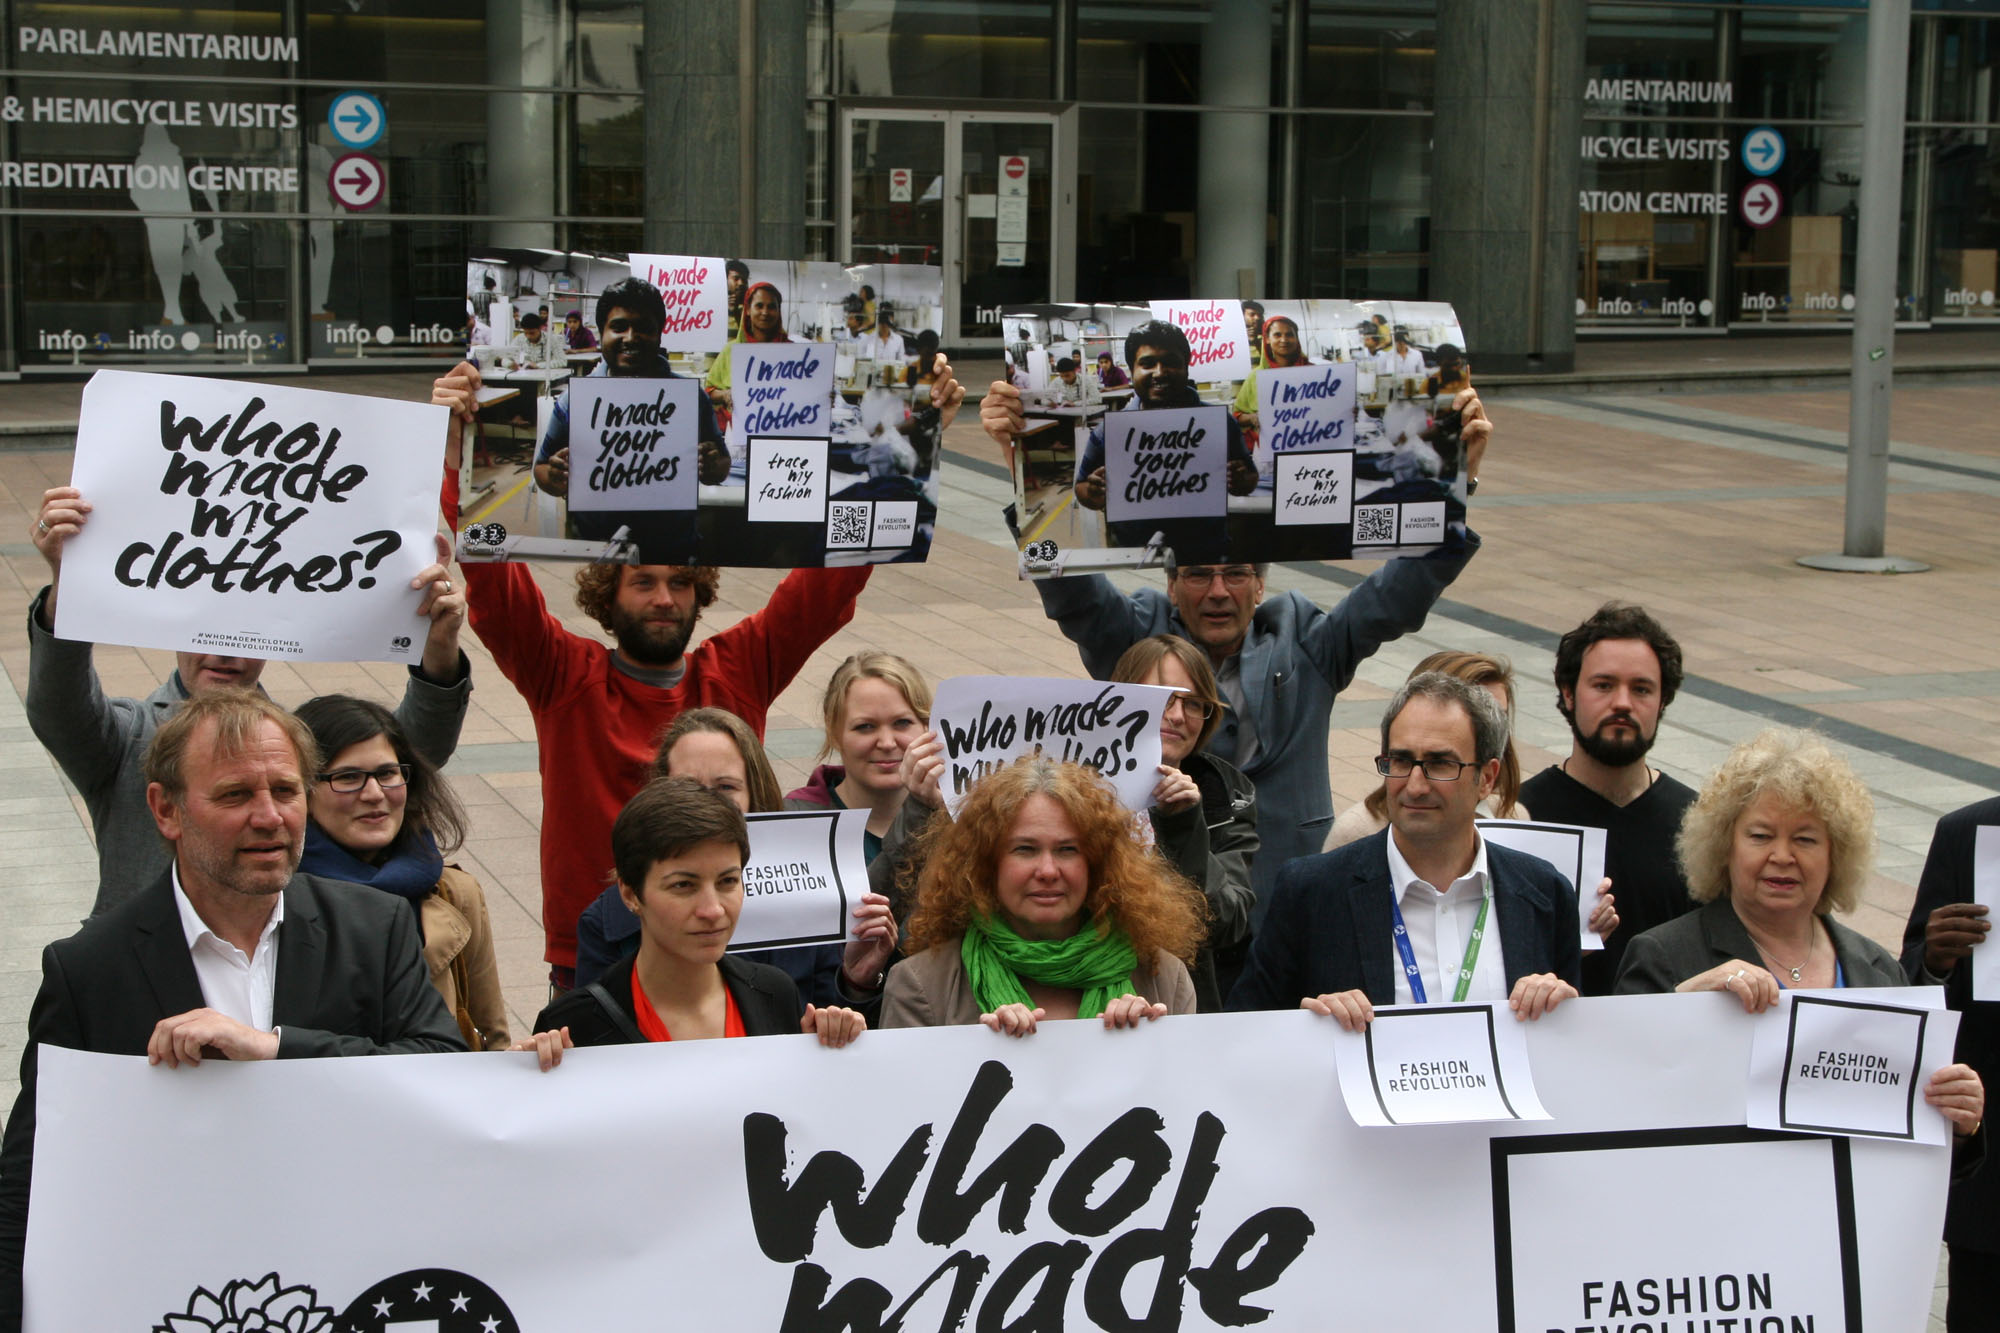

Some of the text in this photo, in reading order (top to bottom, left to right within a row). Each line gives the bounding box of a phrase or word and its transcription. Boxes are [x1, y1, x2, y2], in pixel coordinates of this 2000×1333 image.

[19, 27, 298, 62] PARLAMENTARIUM
[1584, 78, 1733, 103] AMENTARIUM
[1, 96, 298, 129] & HEMICYCLE VISITS
[1665, 138, 1730, 160] VISITS
[0, 162, 298, 192] REDITATION CENTRE
[1647, 192, 1728, 214] CENTRE
[648, 257, 708, 287] I made
[1598, 298, 1695, 315] info info
[1742, 293, 1837, 310] info info
[1945, 288, 1977, 305] info
[662, 307, 714, 334] othes
[976, 304, 1002, 324] inf
[1168, 300, 1224, 326] I made
[39, 330, 262, 350] info info info
[326, 323, 453, 344] info info
[745, 347, 820, 383] I made
[1188, 341, 1235, 367] othes
[745, 386, 787, 407] your
[1271, 368, 1342, 406] I made
[591, 388, 676, 430] I made
[744, 402, 821, 434] clothes
[1272, 406, 1311, 427] your
[160, 397, 320, 463] who
[1125, 416, 1206, 452] I made
[1271, 420, 1344, 450] clothes
[596, 429, 666, 463] your
[160, 427, 369, 502] made
[589, 453, 680, 492] clothes
[768, 452, 809, 470] trace
[1130, 451, 1195, 478] your
[1294, 466, 1334, 481] trace
[788, 469, 813, 486] my
[1124, 470, 1210, 503] clothes
[1314, 480, 1339, 493] my
[759, 482, 812, 503] fashion
[1285, 492, 1337, 509] fashion
[190, 497, 310, 549] my
[114, 531, 402, 593] clothes?
[191, 638, 304, 654] FASHIONREVOLUTION.ORG
[198, 632, 300, 647] #WHOMADEMYCLOTHES
[940, 685, 1125, 759] who made
[745, 862, 810, 881] FASHION
[745, 876, 827, 897] EVOLUTION
[1400, 1060, 1469, 1077] FASHION
[1817, 1051, 1888, 1069] FASHION
[1389, 1074, 1486, 1092] REVOLUTION
[1800, 1064, 1900, 1086] REVOLUTION
[743, 1060, 1172, 1263] who
[780, 1110, 1316, 1333] made
[1583, 1273, 1772, 1319] FASHION
